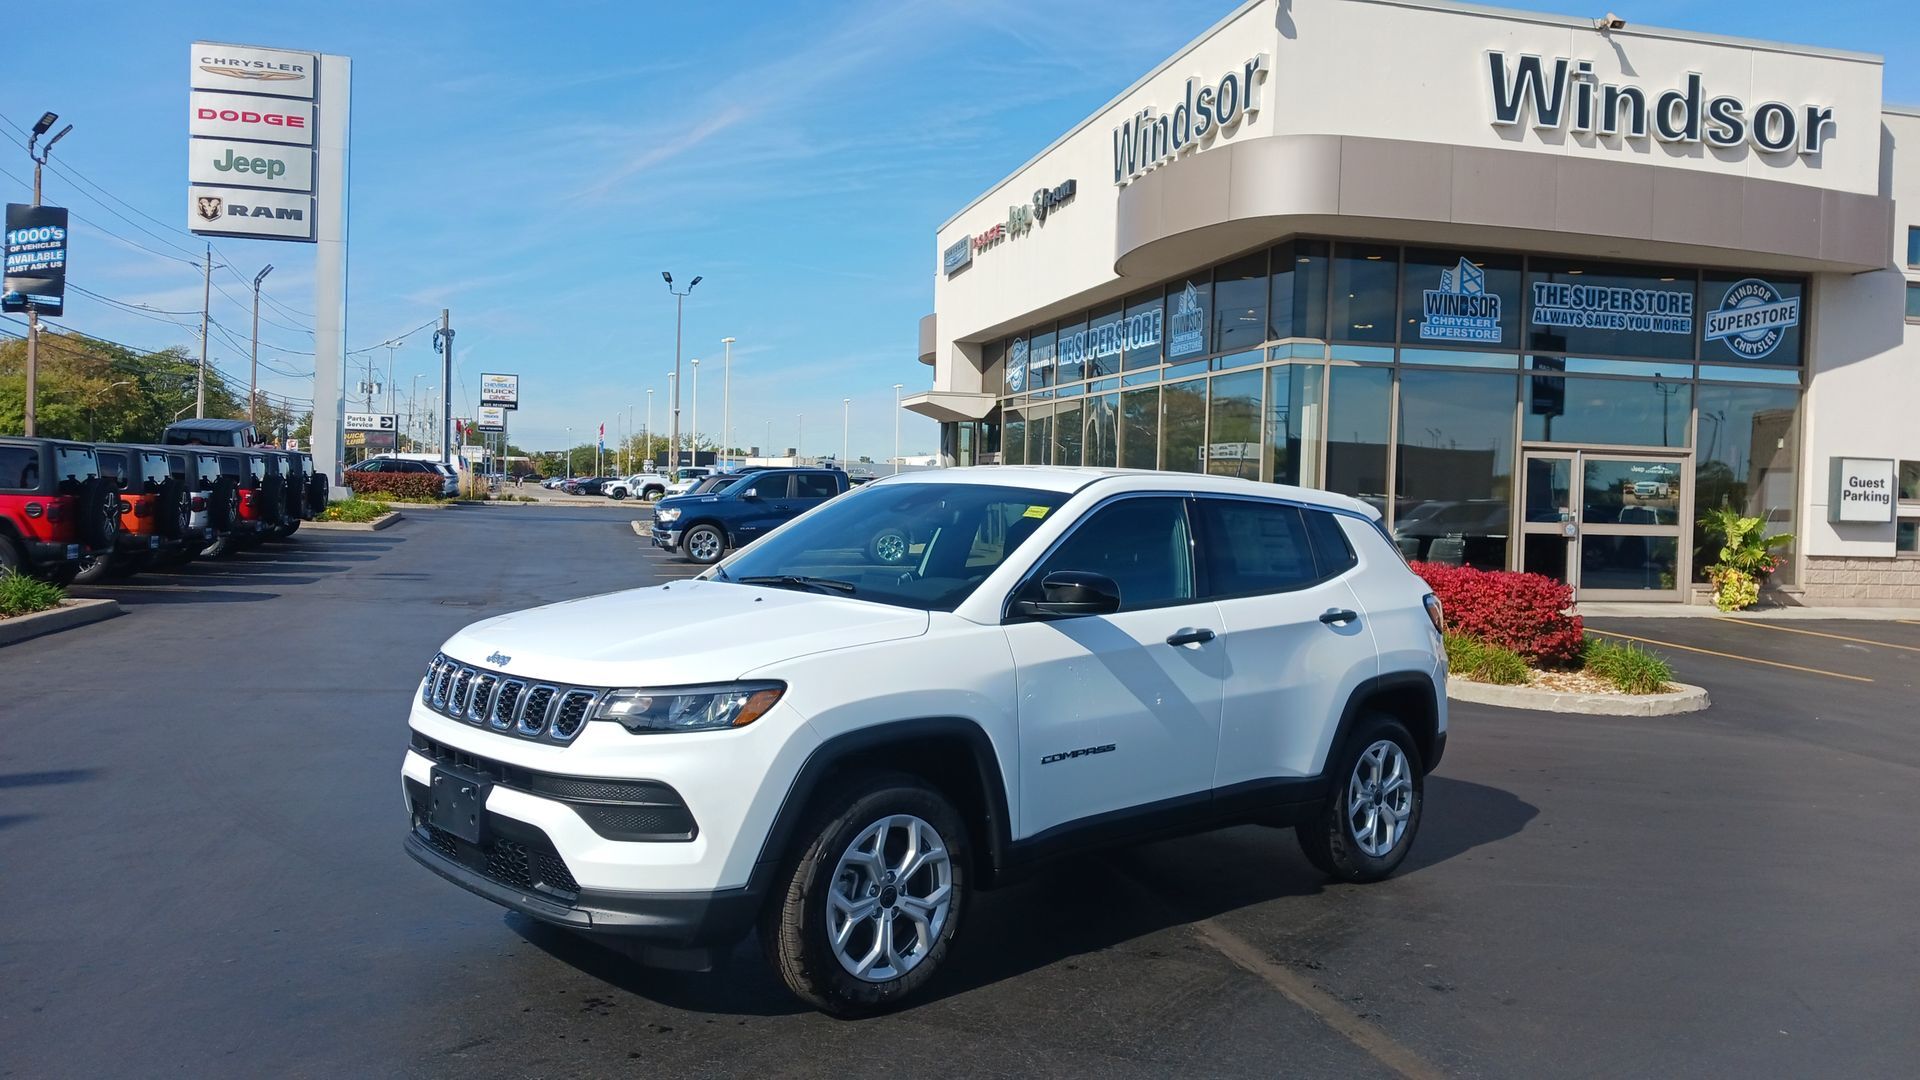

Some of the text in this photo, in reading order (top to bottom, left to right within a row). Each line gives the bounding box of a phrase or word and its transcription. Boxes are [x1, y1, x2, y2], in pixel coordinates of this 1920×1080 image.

[201, 57, 304, 72] CHRYSLER
[1487, 50, 1834, 154] Windsor
[198, 108, 305, 128] DODGE
[1112, 53, 1269, 186] Windsor
[213, 149, 286, 180] Jeep
[228, 204, 303, 221] RAM
[7, 226, 65, 245] 1000's
[10, 241, 61, 252] OF VEHICLES
[7, 250, 64, 266] AVAILABLE
[7, 260, 63, 273] JUST ASK US
[1534, 284, 1691, 315] THE SUPERSTORE
[1727, 284, 1772, 306] WINDSOR
[1426, 293, 1498, 318] WINDSOR
[1431, 316, 1491, 328] CHRYSLER
[1534, 309, 1691, 333] ALWAYS SAVES YOU MORE!
[1708, 305, 1796, 333] SUPERSTORE
[1058, 339, 1073, 365] THE
[1074, 312, 1161, 363] SUPERSTORE
[1423, 326, 1500, 339] SUPERSTORE
[1734, 330, 1777, 354] CHRYSLER
[1849, 475, 1885, 489] Guest
[1843, 489, 1890, 505] Parking
[486, 650, 512, 667] Jeep
[1041, 743, 1116, 764] COMPASS
